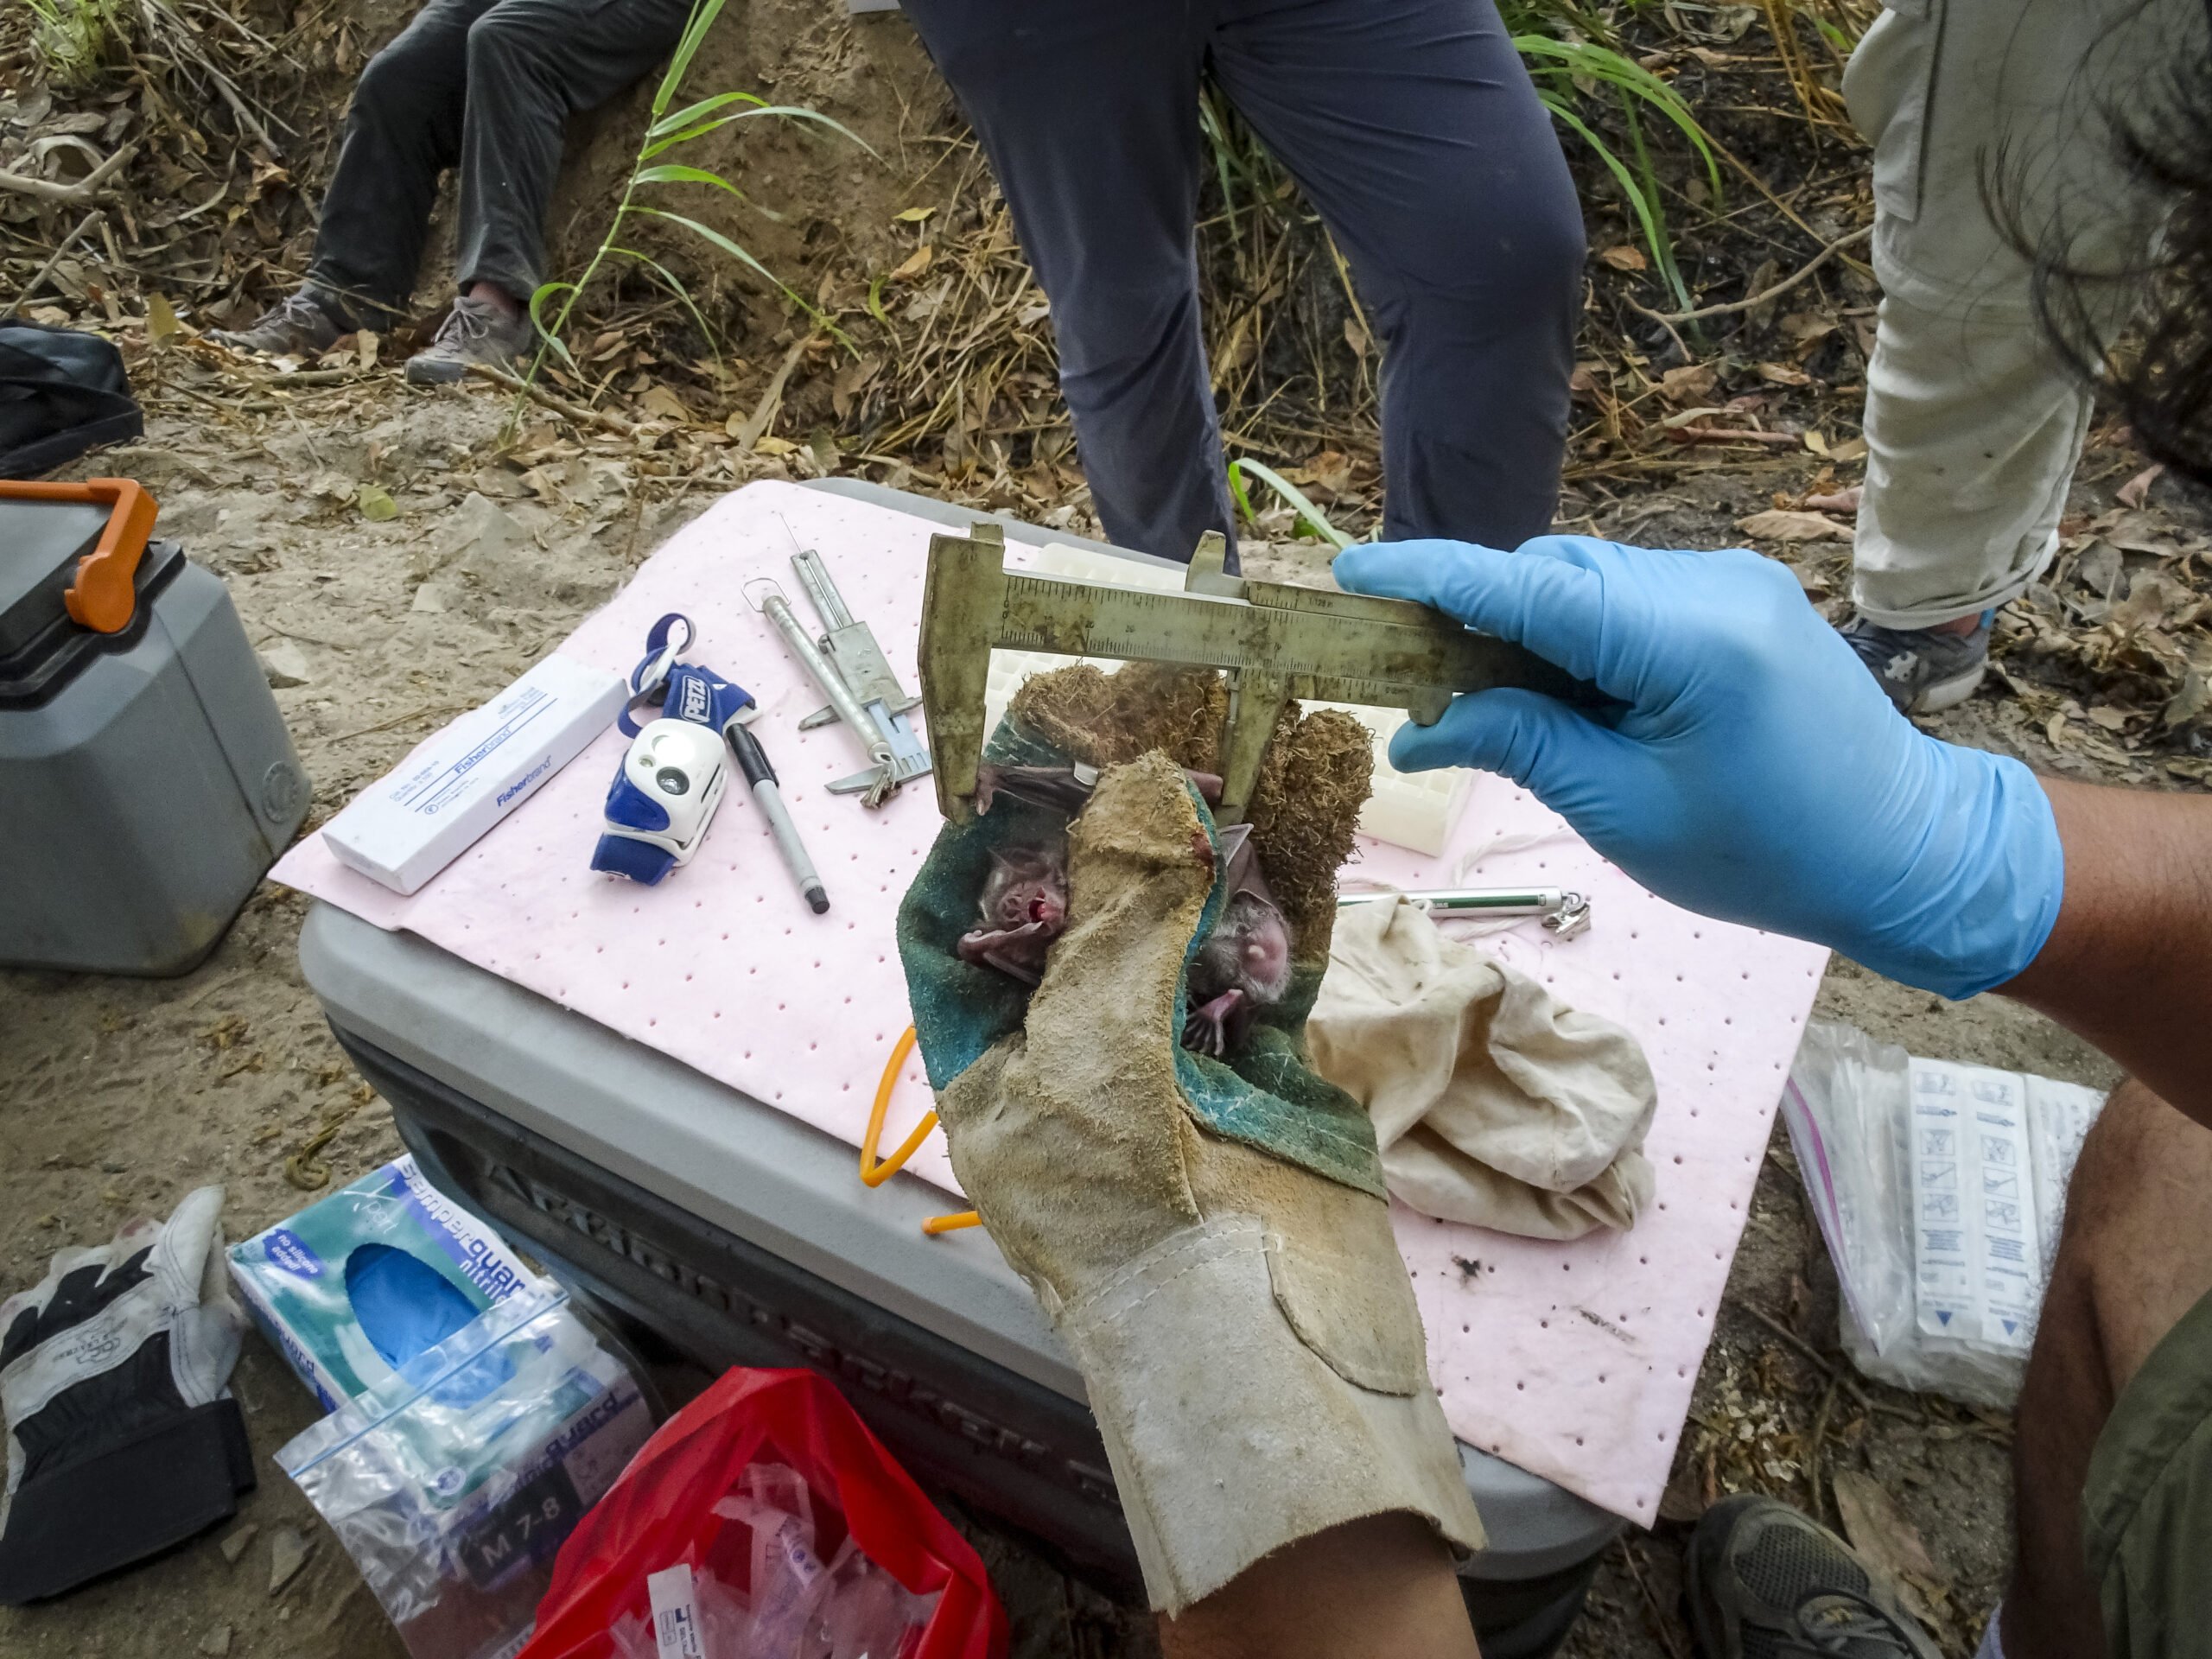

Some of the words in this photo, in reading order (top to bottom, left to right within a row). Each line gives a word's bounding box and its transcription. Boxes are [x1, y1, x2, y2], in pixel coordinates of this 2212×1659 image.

[683, 677, 711, 723] PETZL
[453, 728, 513, 775] Fisherbrand
[495, 757, 551, 808] Fisherbrand
[277, 1234, 291, 1247] no
[288, 1245, 319, 1274] silicone
[480, 1534, 512, 1569] M
[516, 1496, 562, 1541] 7-8
